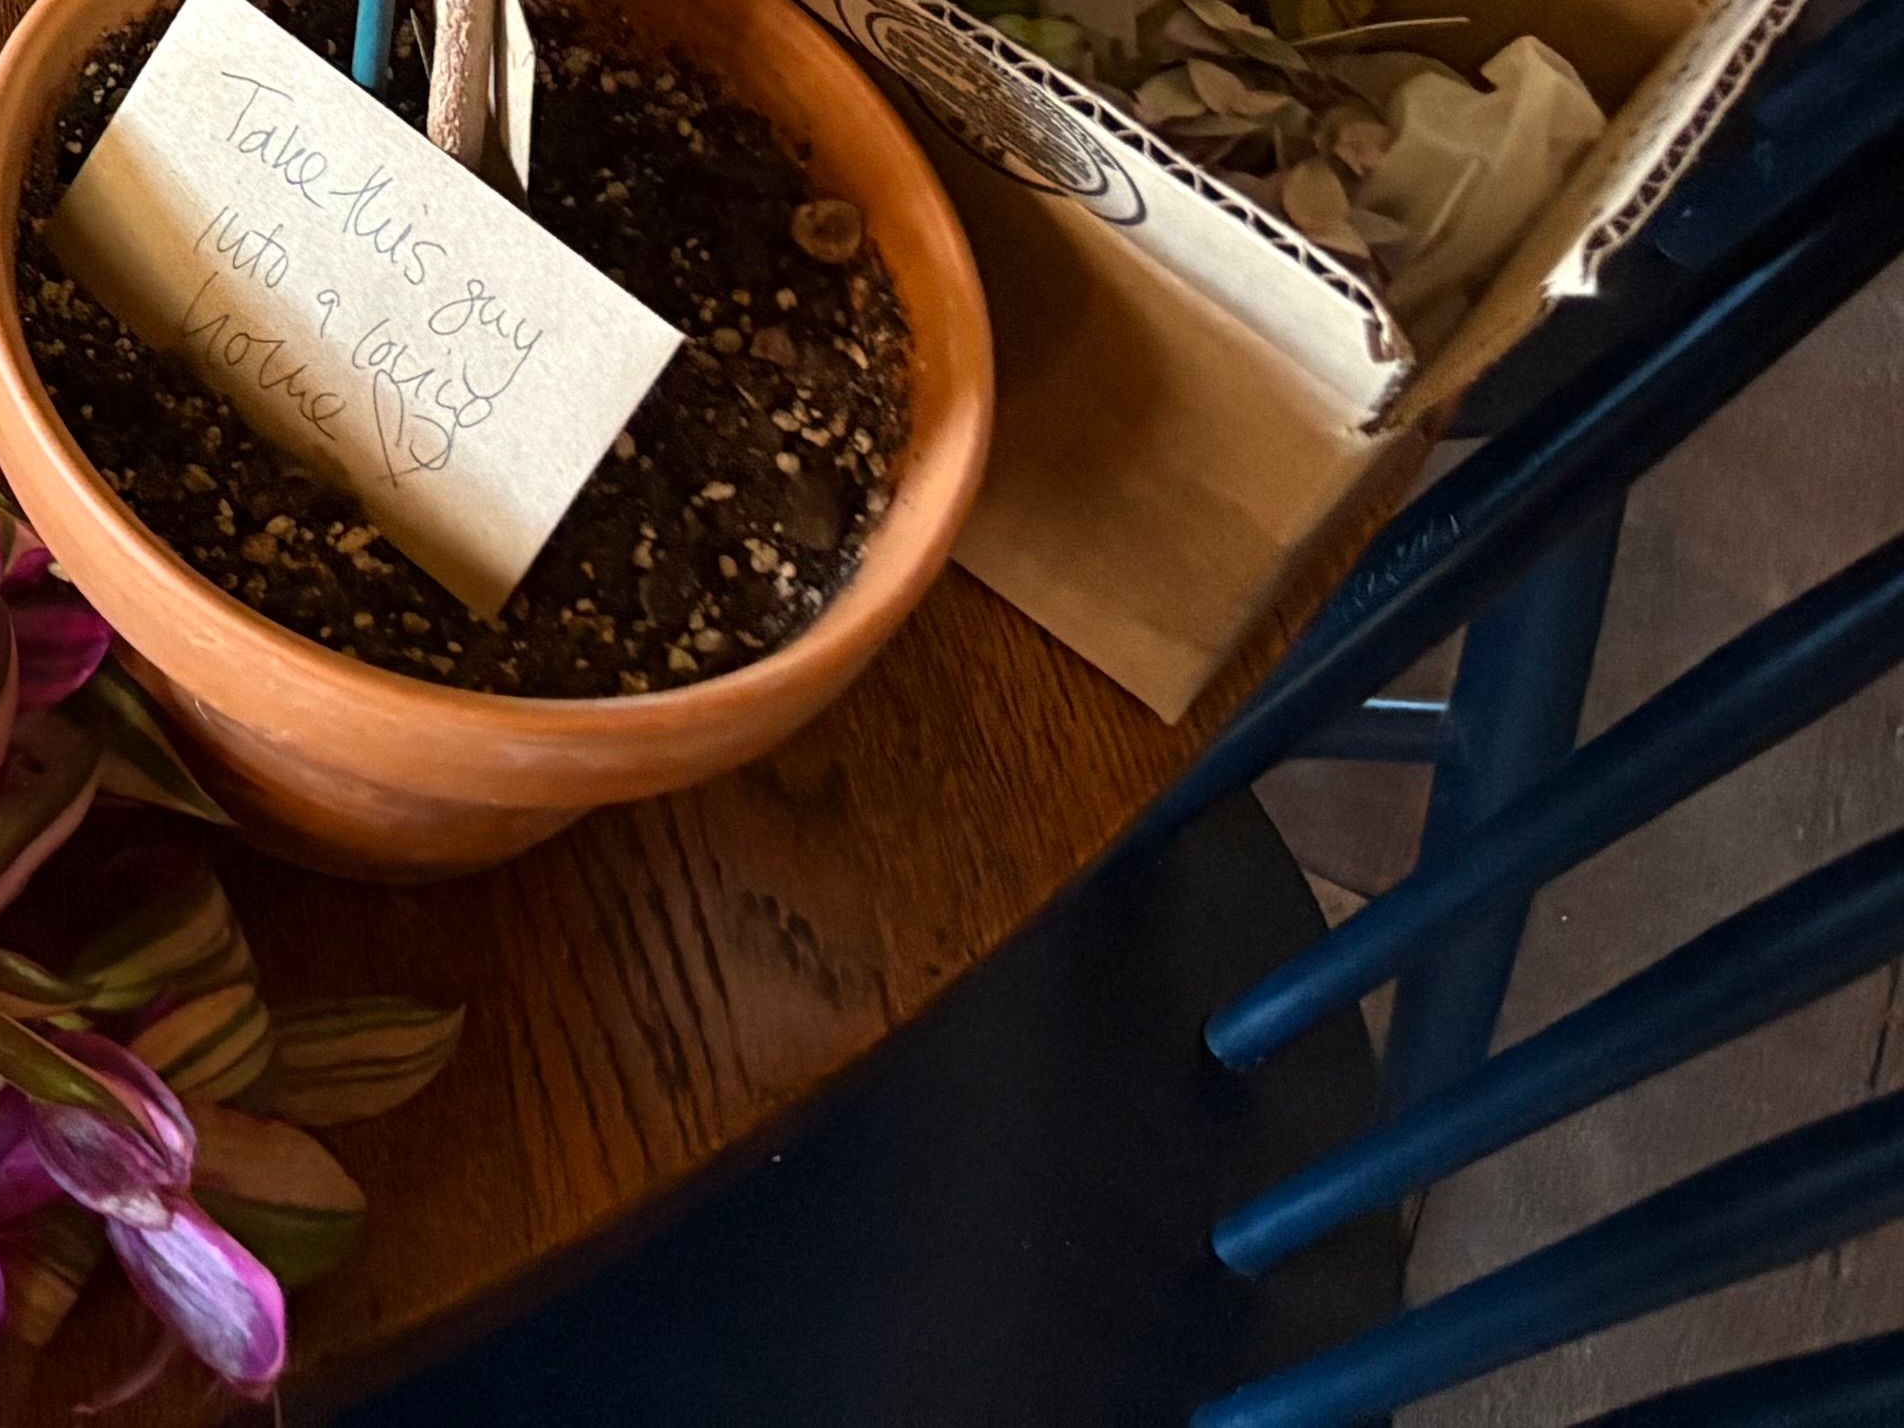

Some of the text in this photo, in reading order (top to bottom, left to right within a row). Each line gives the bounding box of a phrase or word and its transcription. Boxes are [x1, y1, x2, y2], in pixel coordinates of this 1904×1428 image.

[193, 205, 294, 290] into
[318, 287, 342, 338] a
[219, 69, 545, 402] Take this guy
[184, 269, 347, 443] home
